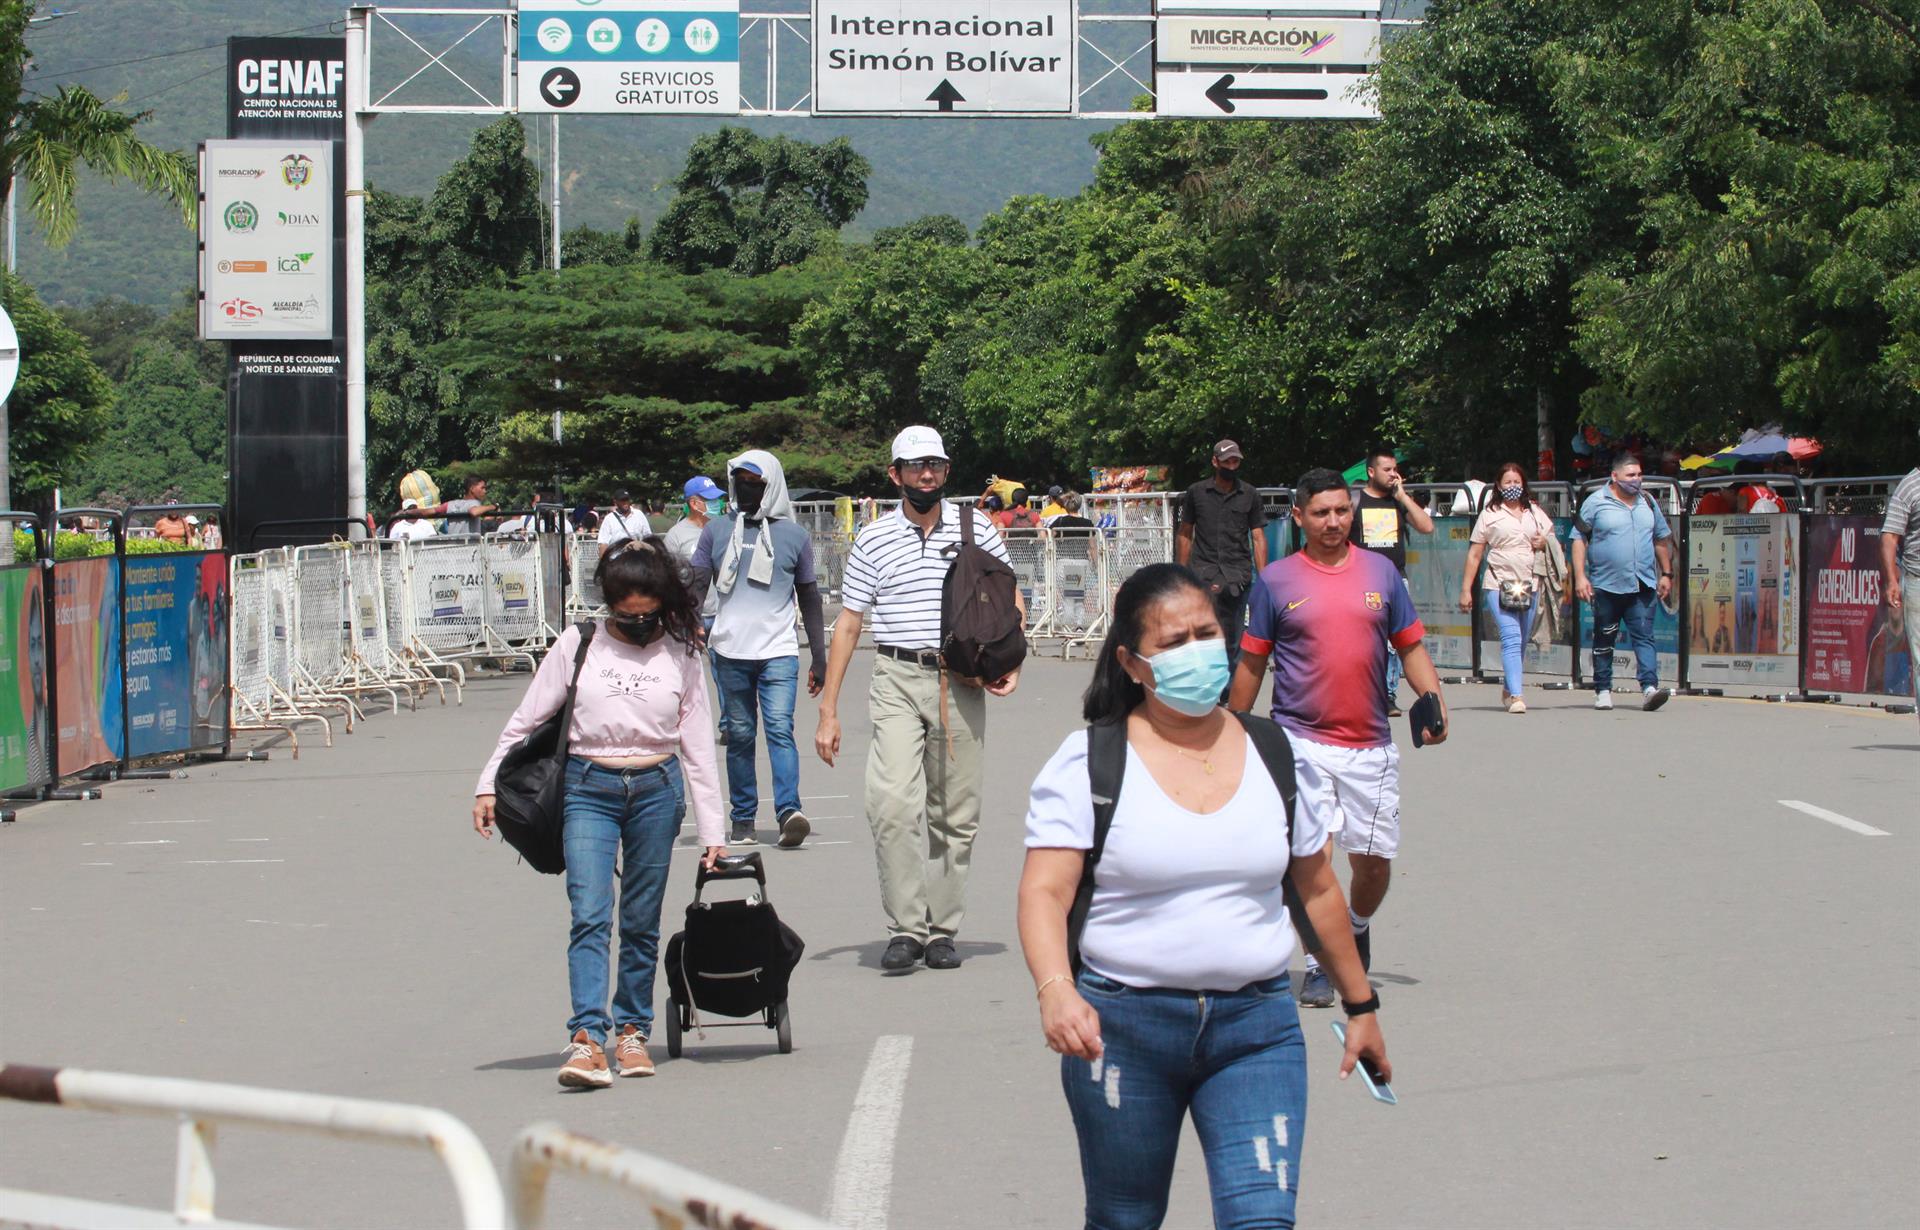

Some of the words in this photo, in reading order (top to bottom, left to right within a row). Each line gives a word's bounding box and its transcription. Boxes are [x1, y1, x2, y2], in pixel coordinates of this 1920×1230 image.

[830, 14, 1054, 37] Internacional
[1190, 27, 1318, 46] MIGRACIÓN
[828, 47, 934, 71] Simón
[945, 49, 1061, 73] Bolívar
[238, 59, 344, 95] CENAF
[619, 71, 714, 86] SERVICIOS
[243, 99, 277, 108] CENTRO
[280, 99, 325, 108] NACIONAL
[326, 99, 337, 108] DE
[615, 90, 719, 105] GRATUITOS
[238, 108, 282, 118] ATENCIÓN
[283, 110, 295, 118] EN
[297, 110, 343, 118] FRONTERAS
[218, 168, 260, 176] MIGRACIÓN
[288, 214, 320, 225] DIAN
[277, 256, 300, 272] ica
[239, 353, 281, 364] REPÚBLICA
[283, 356, 294, 364] DE
[295, 356, 341, 364] COLOMBIA
[246, 366, 272, 374] NORTE
[274, 366, 285, 374] DE
[286, 366, 334, 374] SANTANDER
[1841, 528, 1855, 563] NO
[159, 561, 176, 582] unido
[1818, 568, 1880, 604] GENERALICES
[131, 594, 142, 612] tus
[144, 589, 174, 610] familiares
[131, 618, 156, 642] amigos
[131, 642, 158, 666] estarás
[158, 640, 172, 662] más
[600, 668, 622, 680] She
[629, 672, 661, 683] nice
